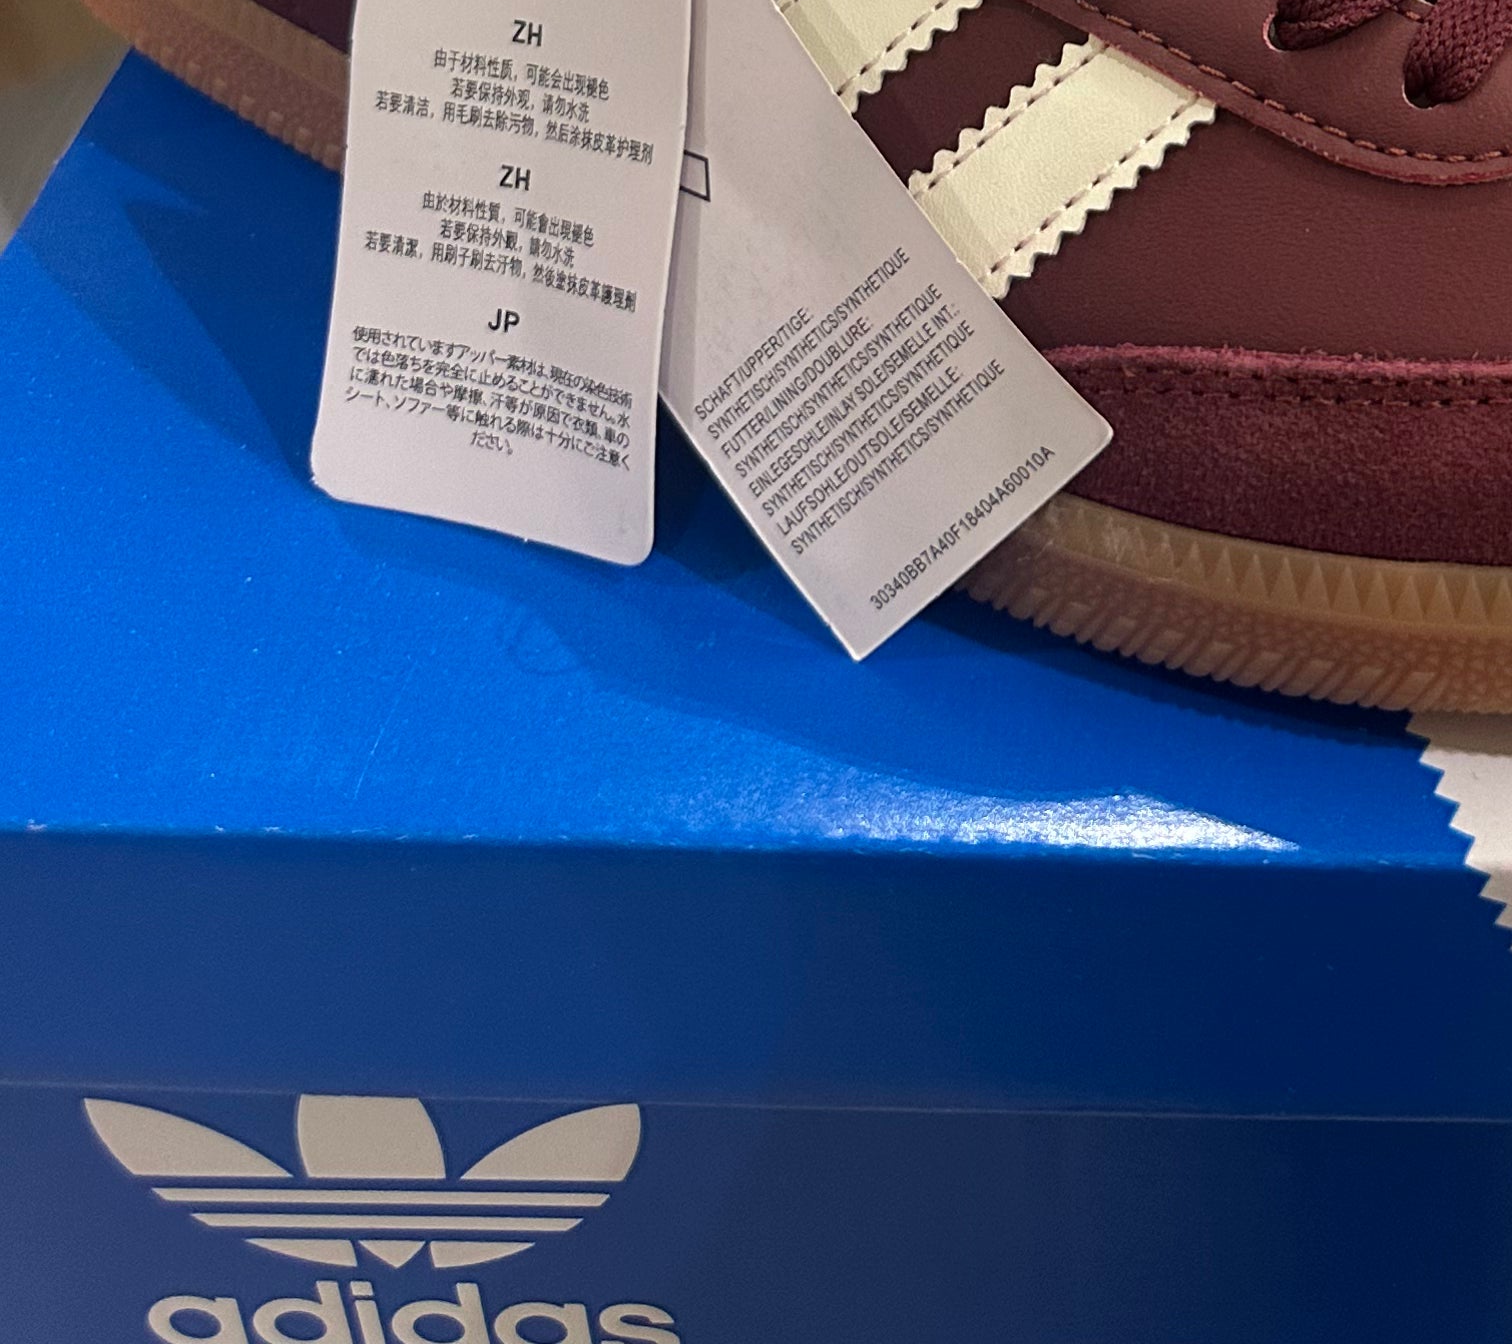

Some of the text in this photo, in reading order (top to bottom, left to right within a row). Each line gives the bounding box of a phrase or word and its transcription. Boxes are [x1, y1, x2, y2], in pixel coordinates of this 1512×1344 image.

[512, 19, 543, 48] ZH
[499, 164, 531, 192] ZH
[487, 308, 521, 332] JP
[694, 306, 815, 422] SCHAFT/UPPER/TIGE:
[708, 246, 910, 441] SYNTHETISCH/SYNTHETICS/SYNTHETIQUE
[720, 315, 873, 460] FUTTER/LINING/DOUBLURE:
[734, 282, 942, 479] SYNTHETISCH/SYNTHETICS/SYNTHETIQUE
[761, 320, 975, 518] SYNTHETISCH/SYNTHETICS/SYNTHETIQUE
[775, 364, 962, 537] LAUFSOHLE/OUTSOLE/SEMELLE:
[789, 358, 1005, 557] SYNTHETISCH/SYNTHETICS/SYNTHETIQUE
[146, 1280, 681, 1344] adidas
